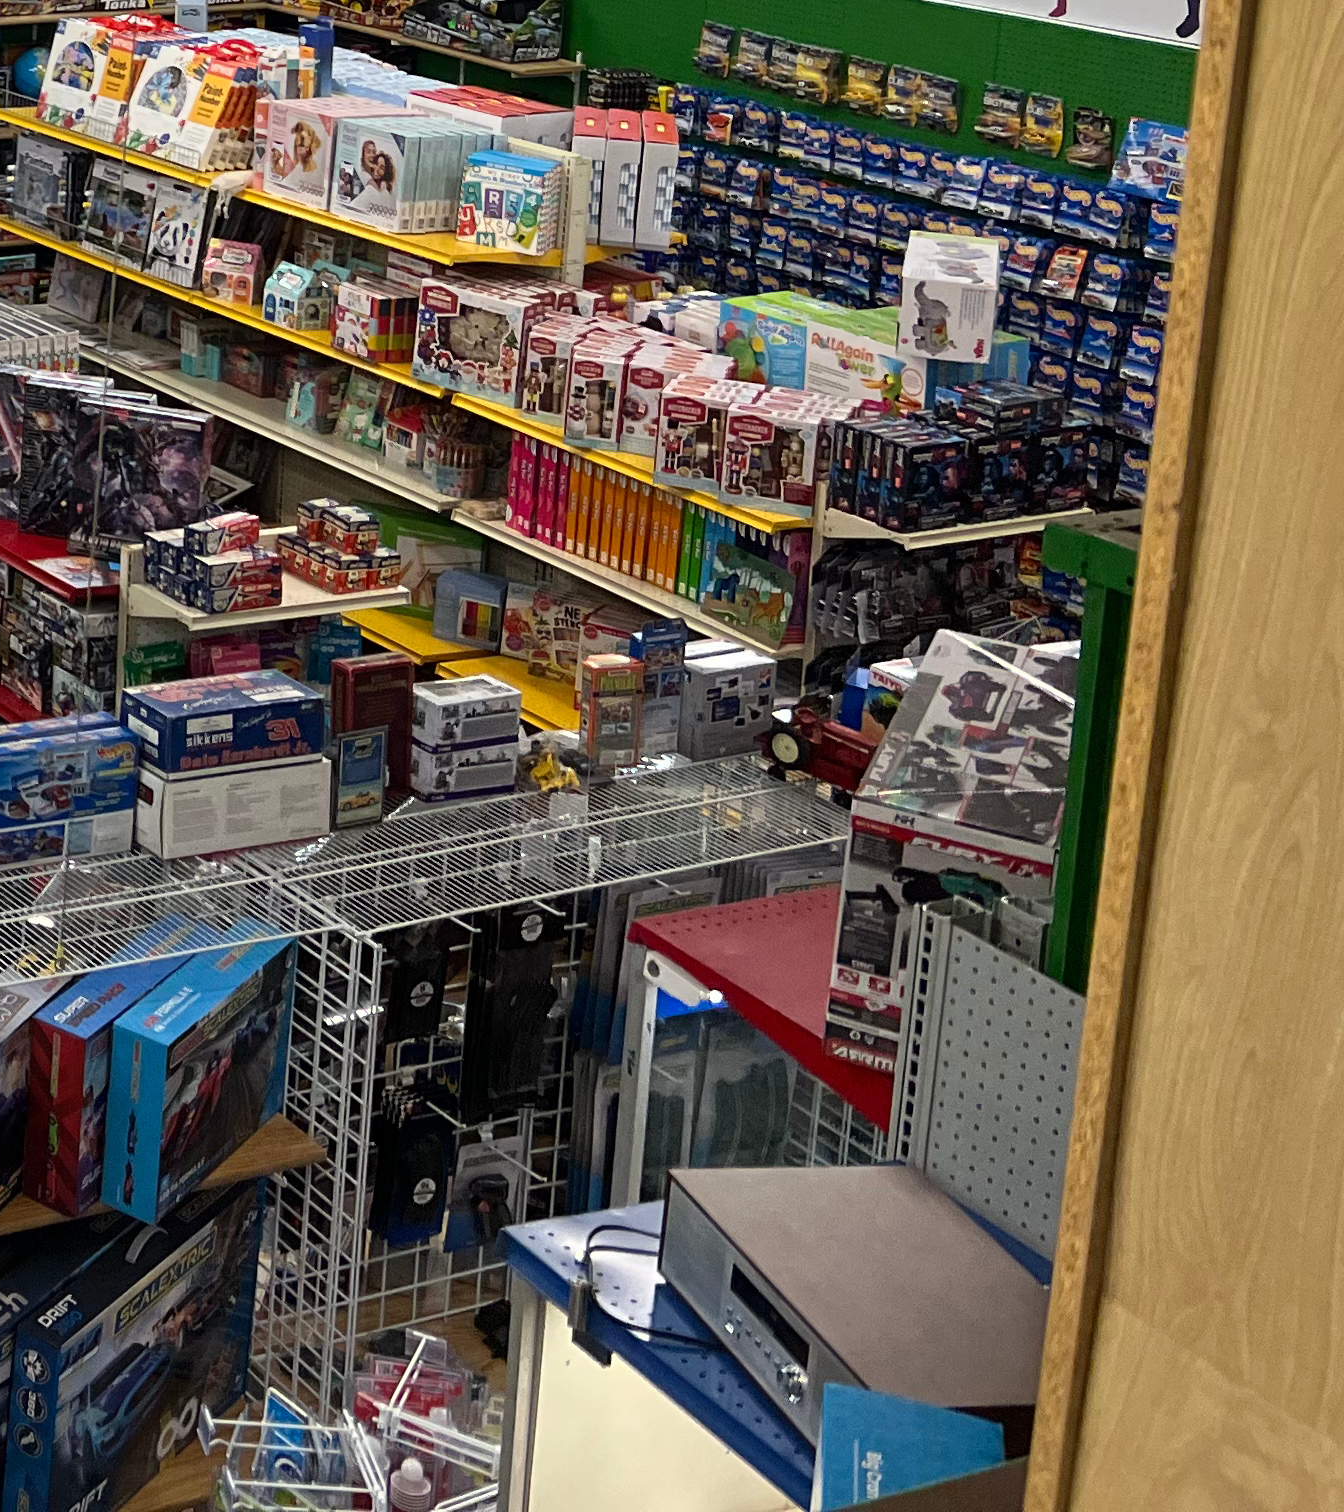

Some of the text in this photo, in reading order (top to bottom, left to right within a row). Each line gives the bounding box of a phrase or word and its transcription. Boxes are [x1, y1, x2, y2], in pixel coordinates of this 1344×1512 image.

[554, 617, 581, 629] STENC
[564, 605, 581, 620] NE
[185, 731, 233, 748] sikkens
[265, 717, 301, 740] 31
[179, 754, 219, 770] Dale
[220, 741, 291, 765] Earnhardt
[53, 995, 90, 1024] SUPER
[832, 1047, 895, 1073] ARRM
[117, 1237, 212, 1326] SCALEXTRIC
[37, 1293, 79, 1329] DRIFT
[68, 1478, 109, 1512] RIFT
